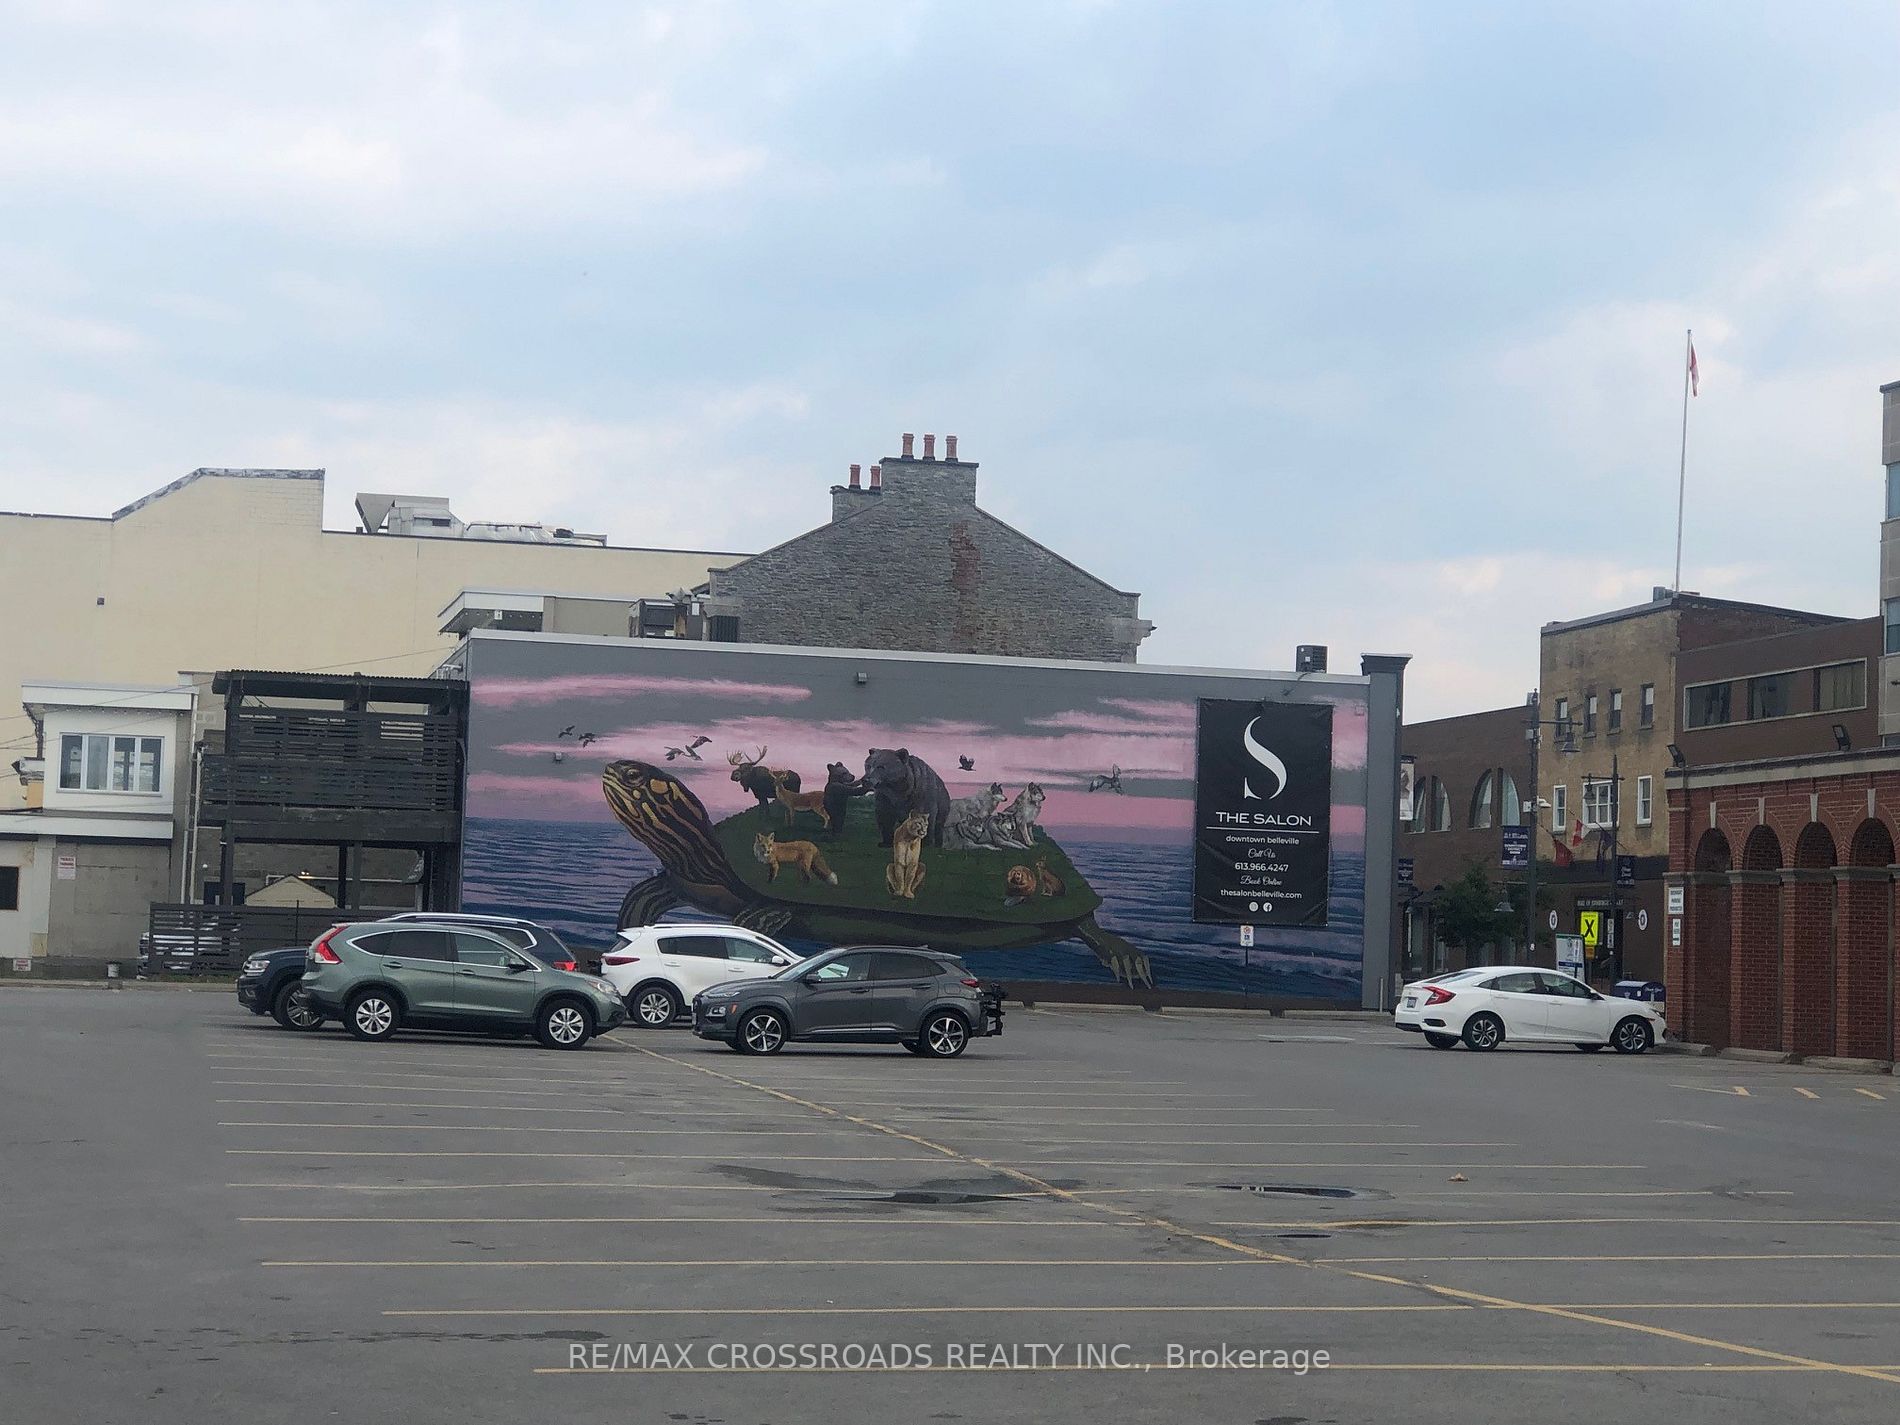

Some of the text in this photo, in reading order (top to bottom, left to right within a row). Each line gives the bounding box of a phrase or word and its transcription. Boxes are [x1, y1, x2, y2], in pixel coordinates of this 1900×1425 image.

[1243, 716, 1287, 799] S
[1216, 811, 1311, 826] THE SALON
[1225, 835, 1300, 845] downtown belleville
[1247, 848, 1263, 859] Call
[1234, 862, 1289, 872] 613.966.4247
[1220, 889, 1302, 899] thesalonbelleville.com
